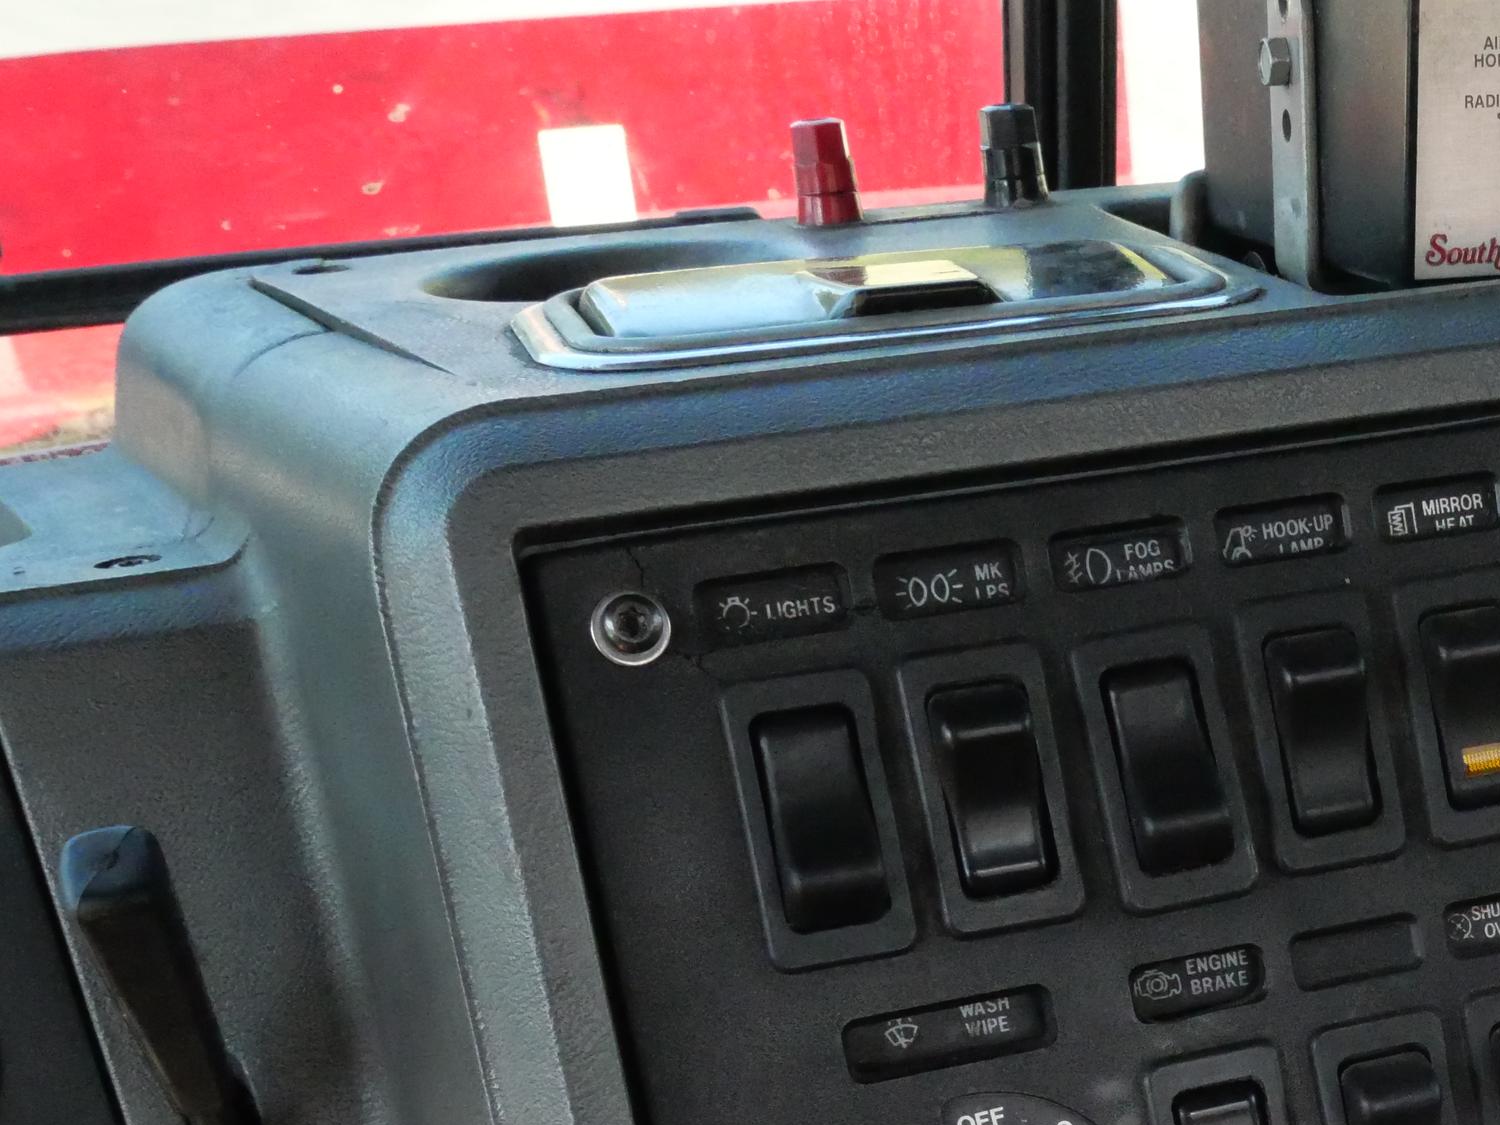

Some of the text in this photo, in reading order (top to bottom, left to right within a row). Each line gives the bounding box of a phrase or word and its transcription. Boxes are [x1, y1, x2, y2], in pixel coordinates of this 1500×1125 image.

[1421, 493, 1483, 516] MIRROR
[1262, 514, 1334, 540] HOOK-UP
[1123, 539, 1161, 561] FOG
[973, 561, 1002, 582] MK
[765, 596, 837, 620] LIGHTS
[1185, 949, 1249, 976] ENGINE
[1190, 970, 1249, 996] BRAKE
[959, 997, 1010, 1018] WASH
[965, 1015, 1010, 1037] WIPE
